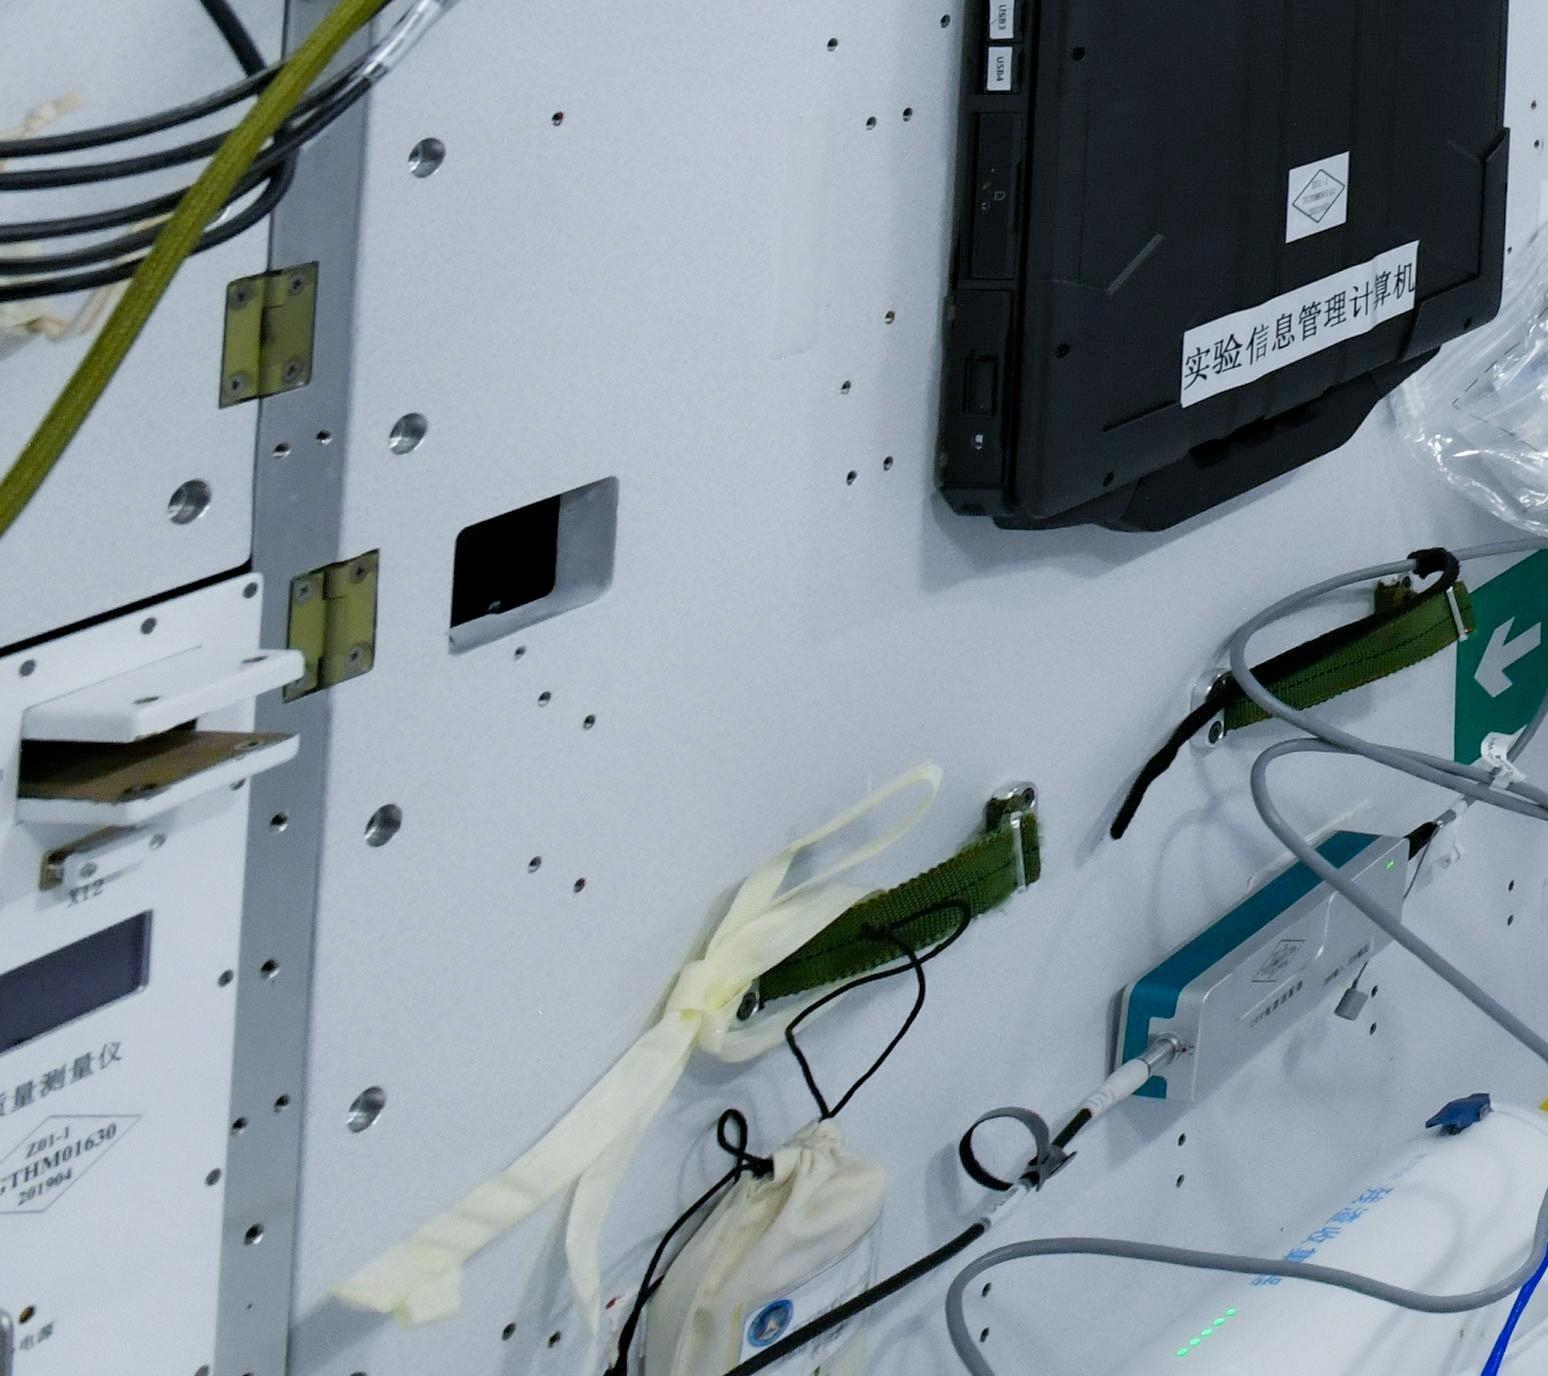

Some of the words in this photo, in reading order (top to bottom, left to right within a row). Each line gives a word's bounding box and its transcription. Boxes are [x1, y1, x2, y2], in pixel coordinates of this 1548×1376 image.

[998, 4, 1007, 31] USB3
[995, 55, 1004, 83] USB4
[1183, 262, 1415, 391] 实验信息管理计算机
[0, 1123, 118, 1198] THM01630
[26, 1126, 71, 1160] Z01-1
[18, 1168, 73, 1207] 201904
